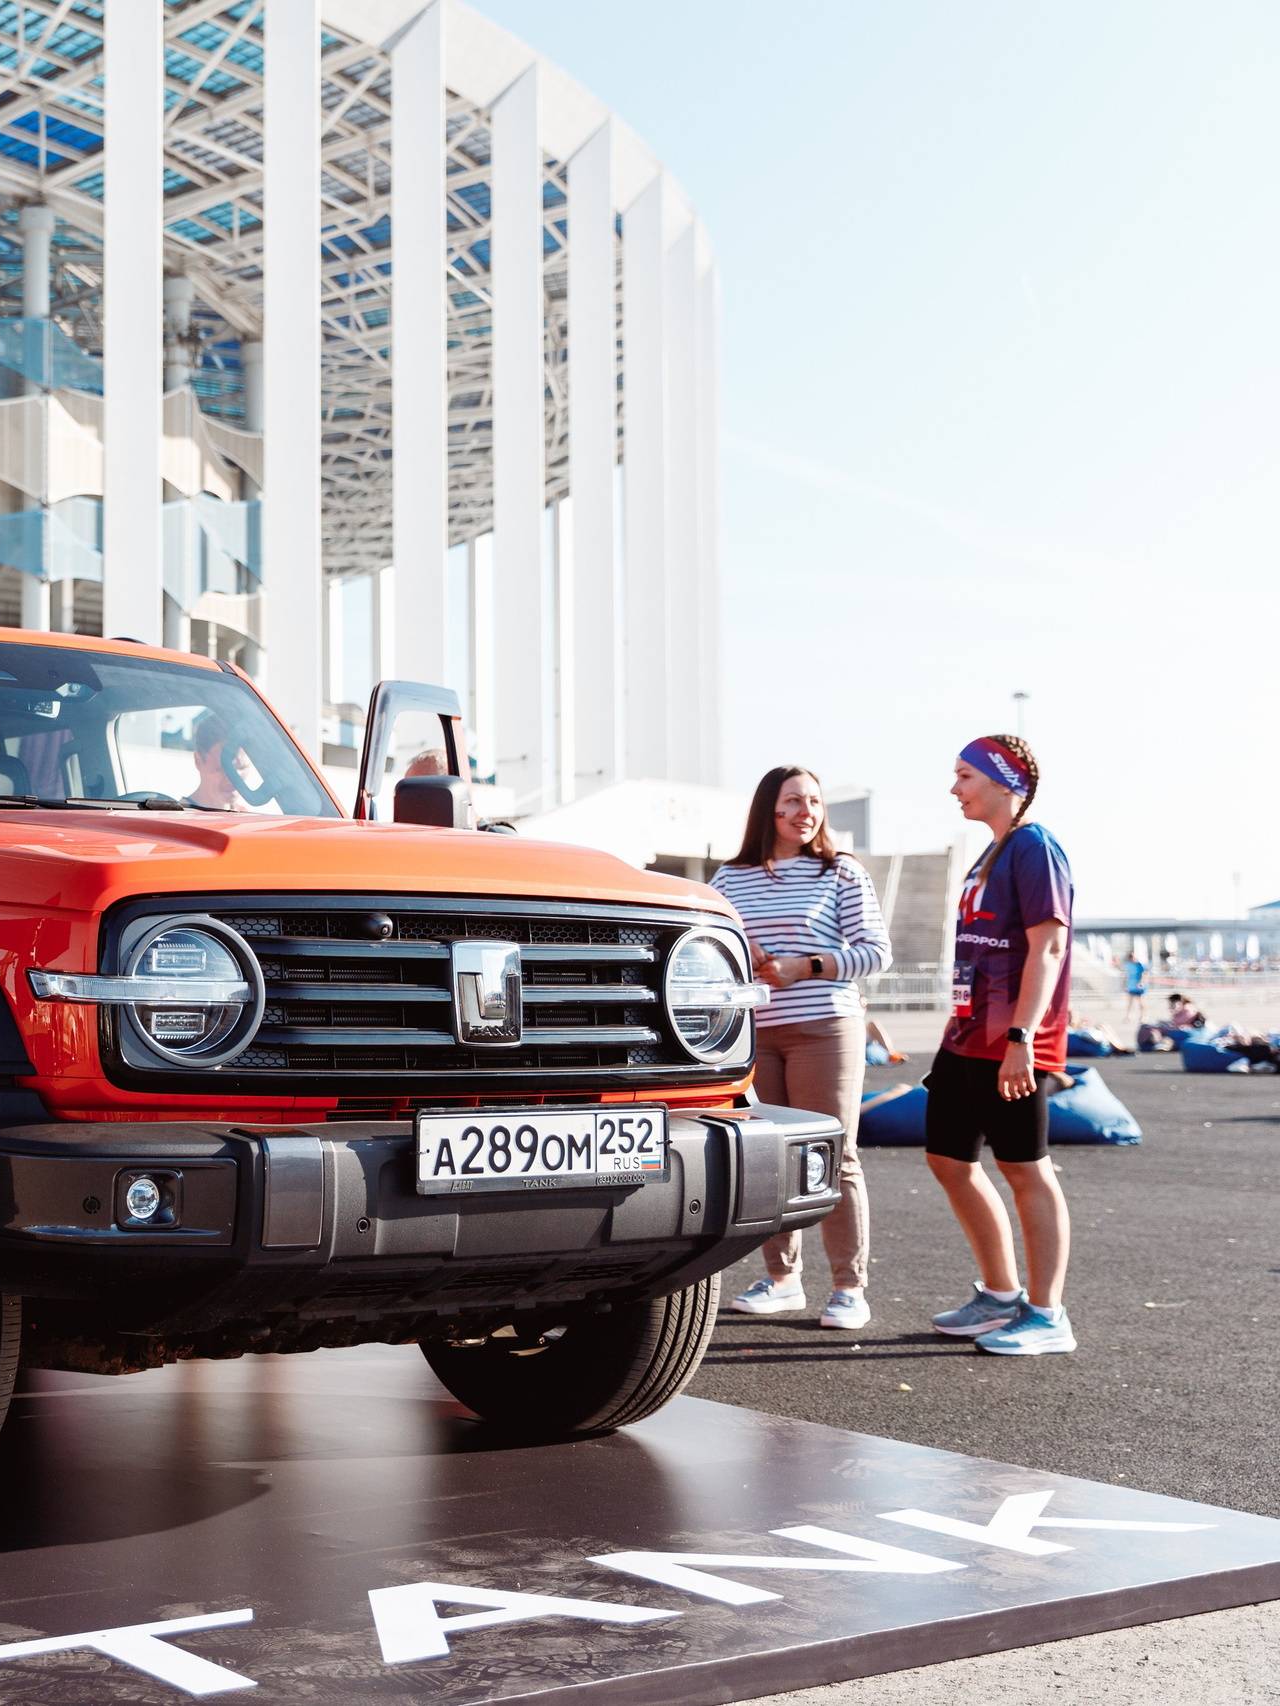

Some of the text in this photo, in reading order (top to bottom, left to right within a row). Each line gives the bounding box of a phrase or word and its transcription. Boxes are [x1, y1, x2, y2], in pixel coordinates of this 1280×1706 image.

[470, 1025, 517, 1036] TANK
[599, 1118, 654, 1155] 252
[613, 1157, 641, 1170] RUS
[522, 1178, 557, 1188] TANK
